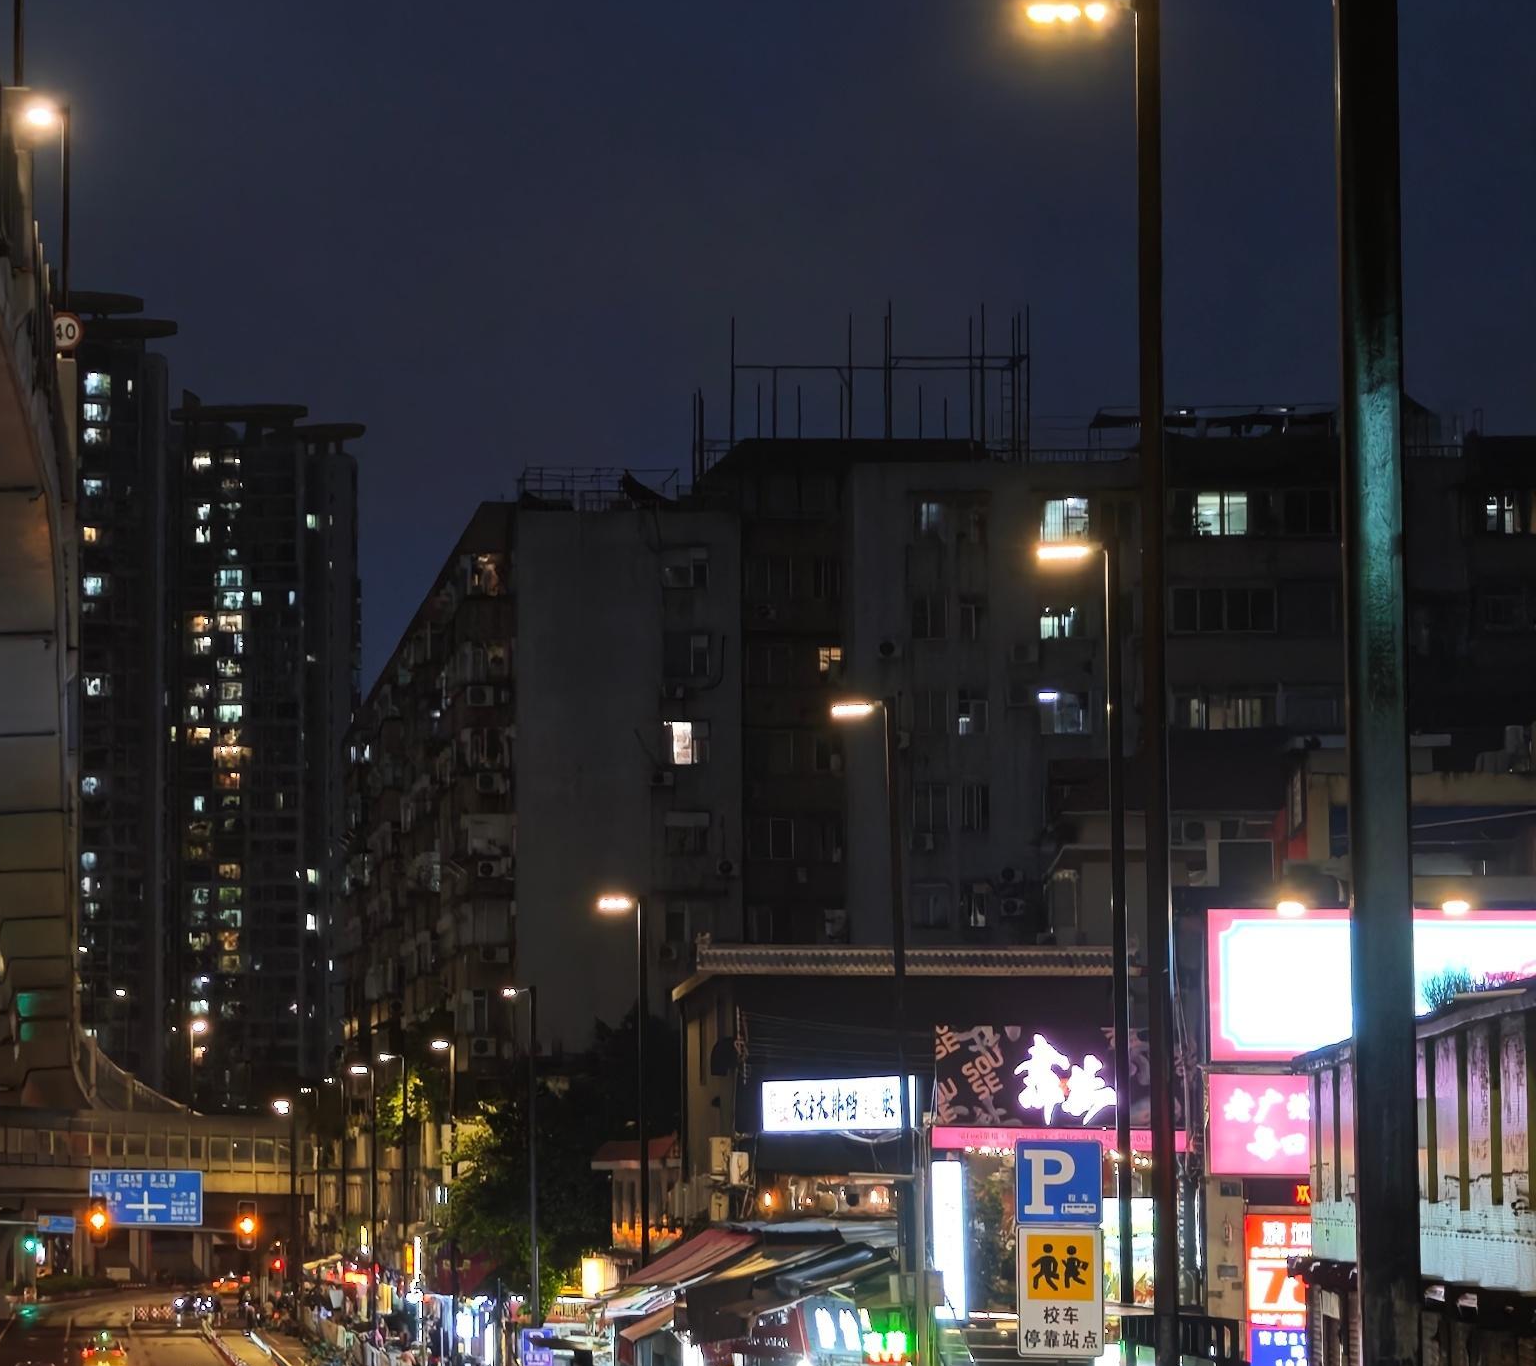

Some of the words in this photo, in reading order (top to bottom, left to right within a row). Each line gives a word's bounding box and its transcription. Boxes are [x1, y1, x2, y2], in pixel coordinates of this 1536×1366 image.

[961, 1045, 1004, 1083] SOU
[1023, 1149, 1076, 1215] P
[1043, 1306, 1079, 1325] 校车
[1023, 1329, 1098, 1349] 停靠站点
